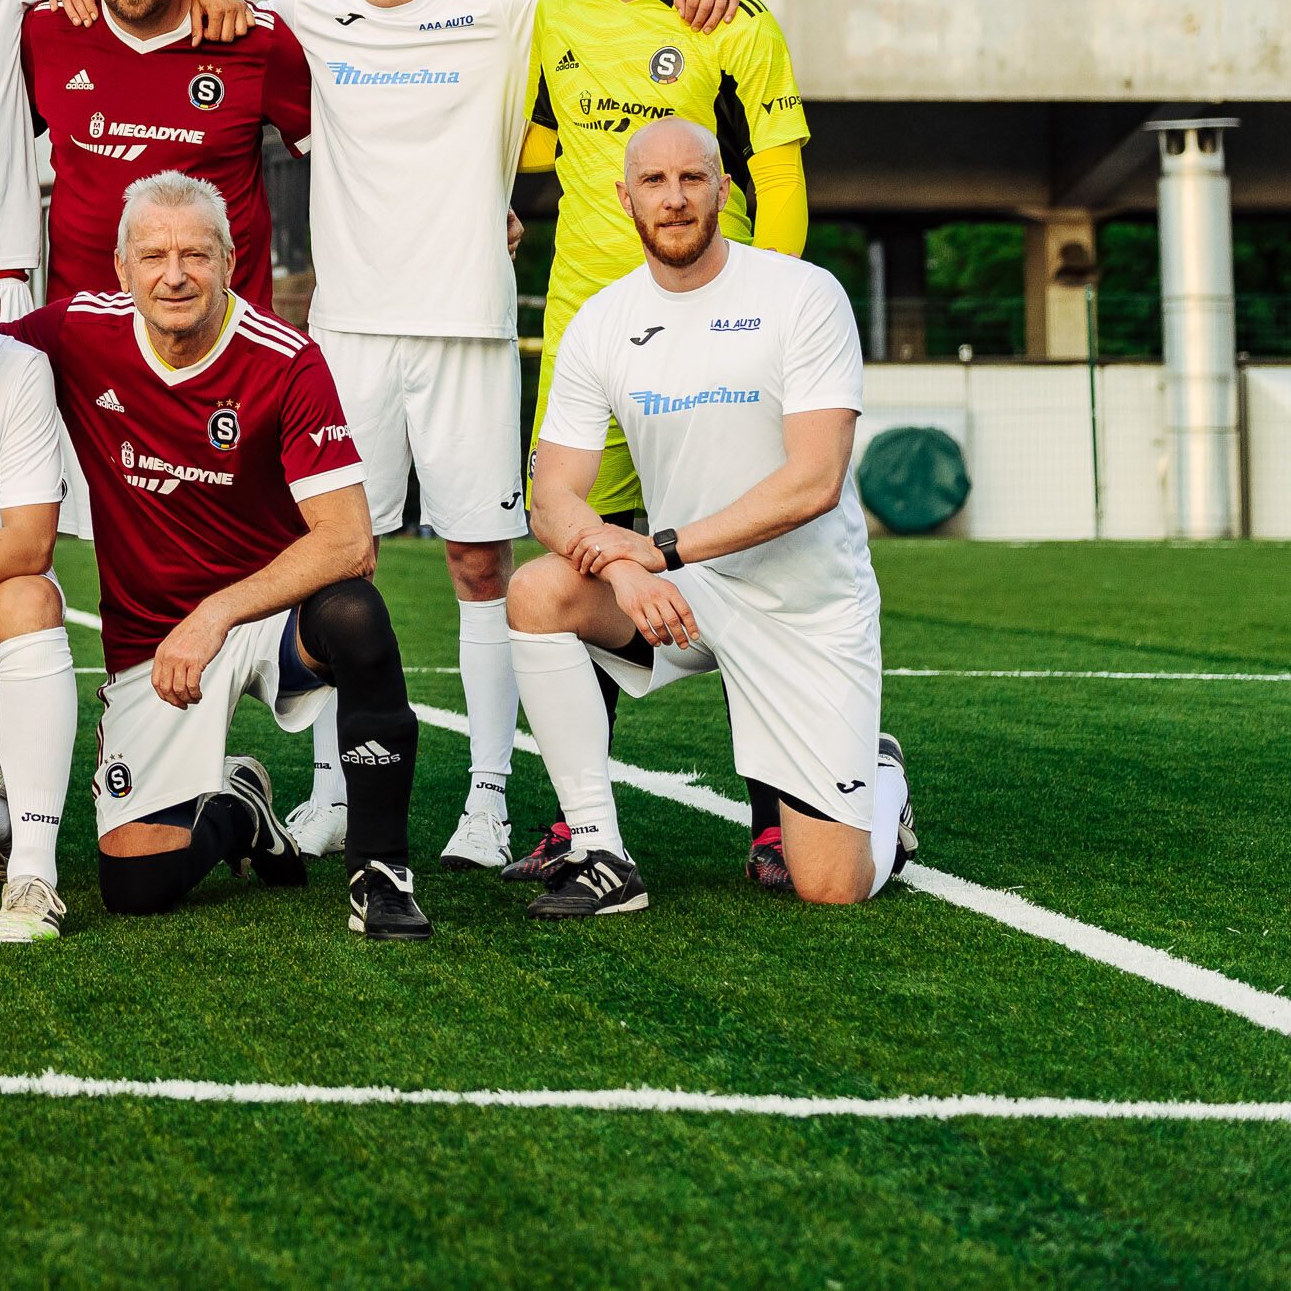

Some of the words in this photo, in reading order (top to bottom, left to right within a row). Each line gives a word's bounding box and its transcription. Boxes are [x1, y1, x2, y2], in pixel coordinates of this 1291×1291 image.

[419, 22, 442, 31] AAA
[445, 15, 474, 28] AUTO
[326, 62, 460, 85] Mototechna
[555, 62, 580, 72] adidas
[66, 82, 94, 90] adidas
[108, 122, 206, 145] MEGADYNE
[733, 317, 761, 329] AUTO
[95, 399, 125, 413] adidas
[138, 454, 234, 486] MEGADYNE
[341, 753, 401, 766] adidas
